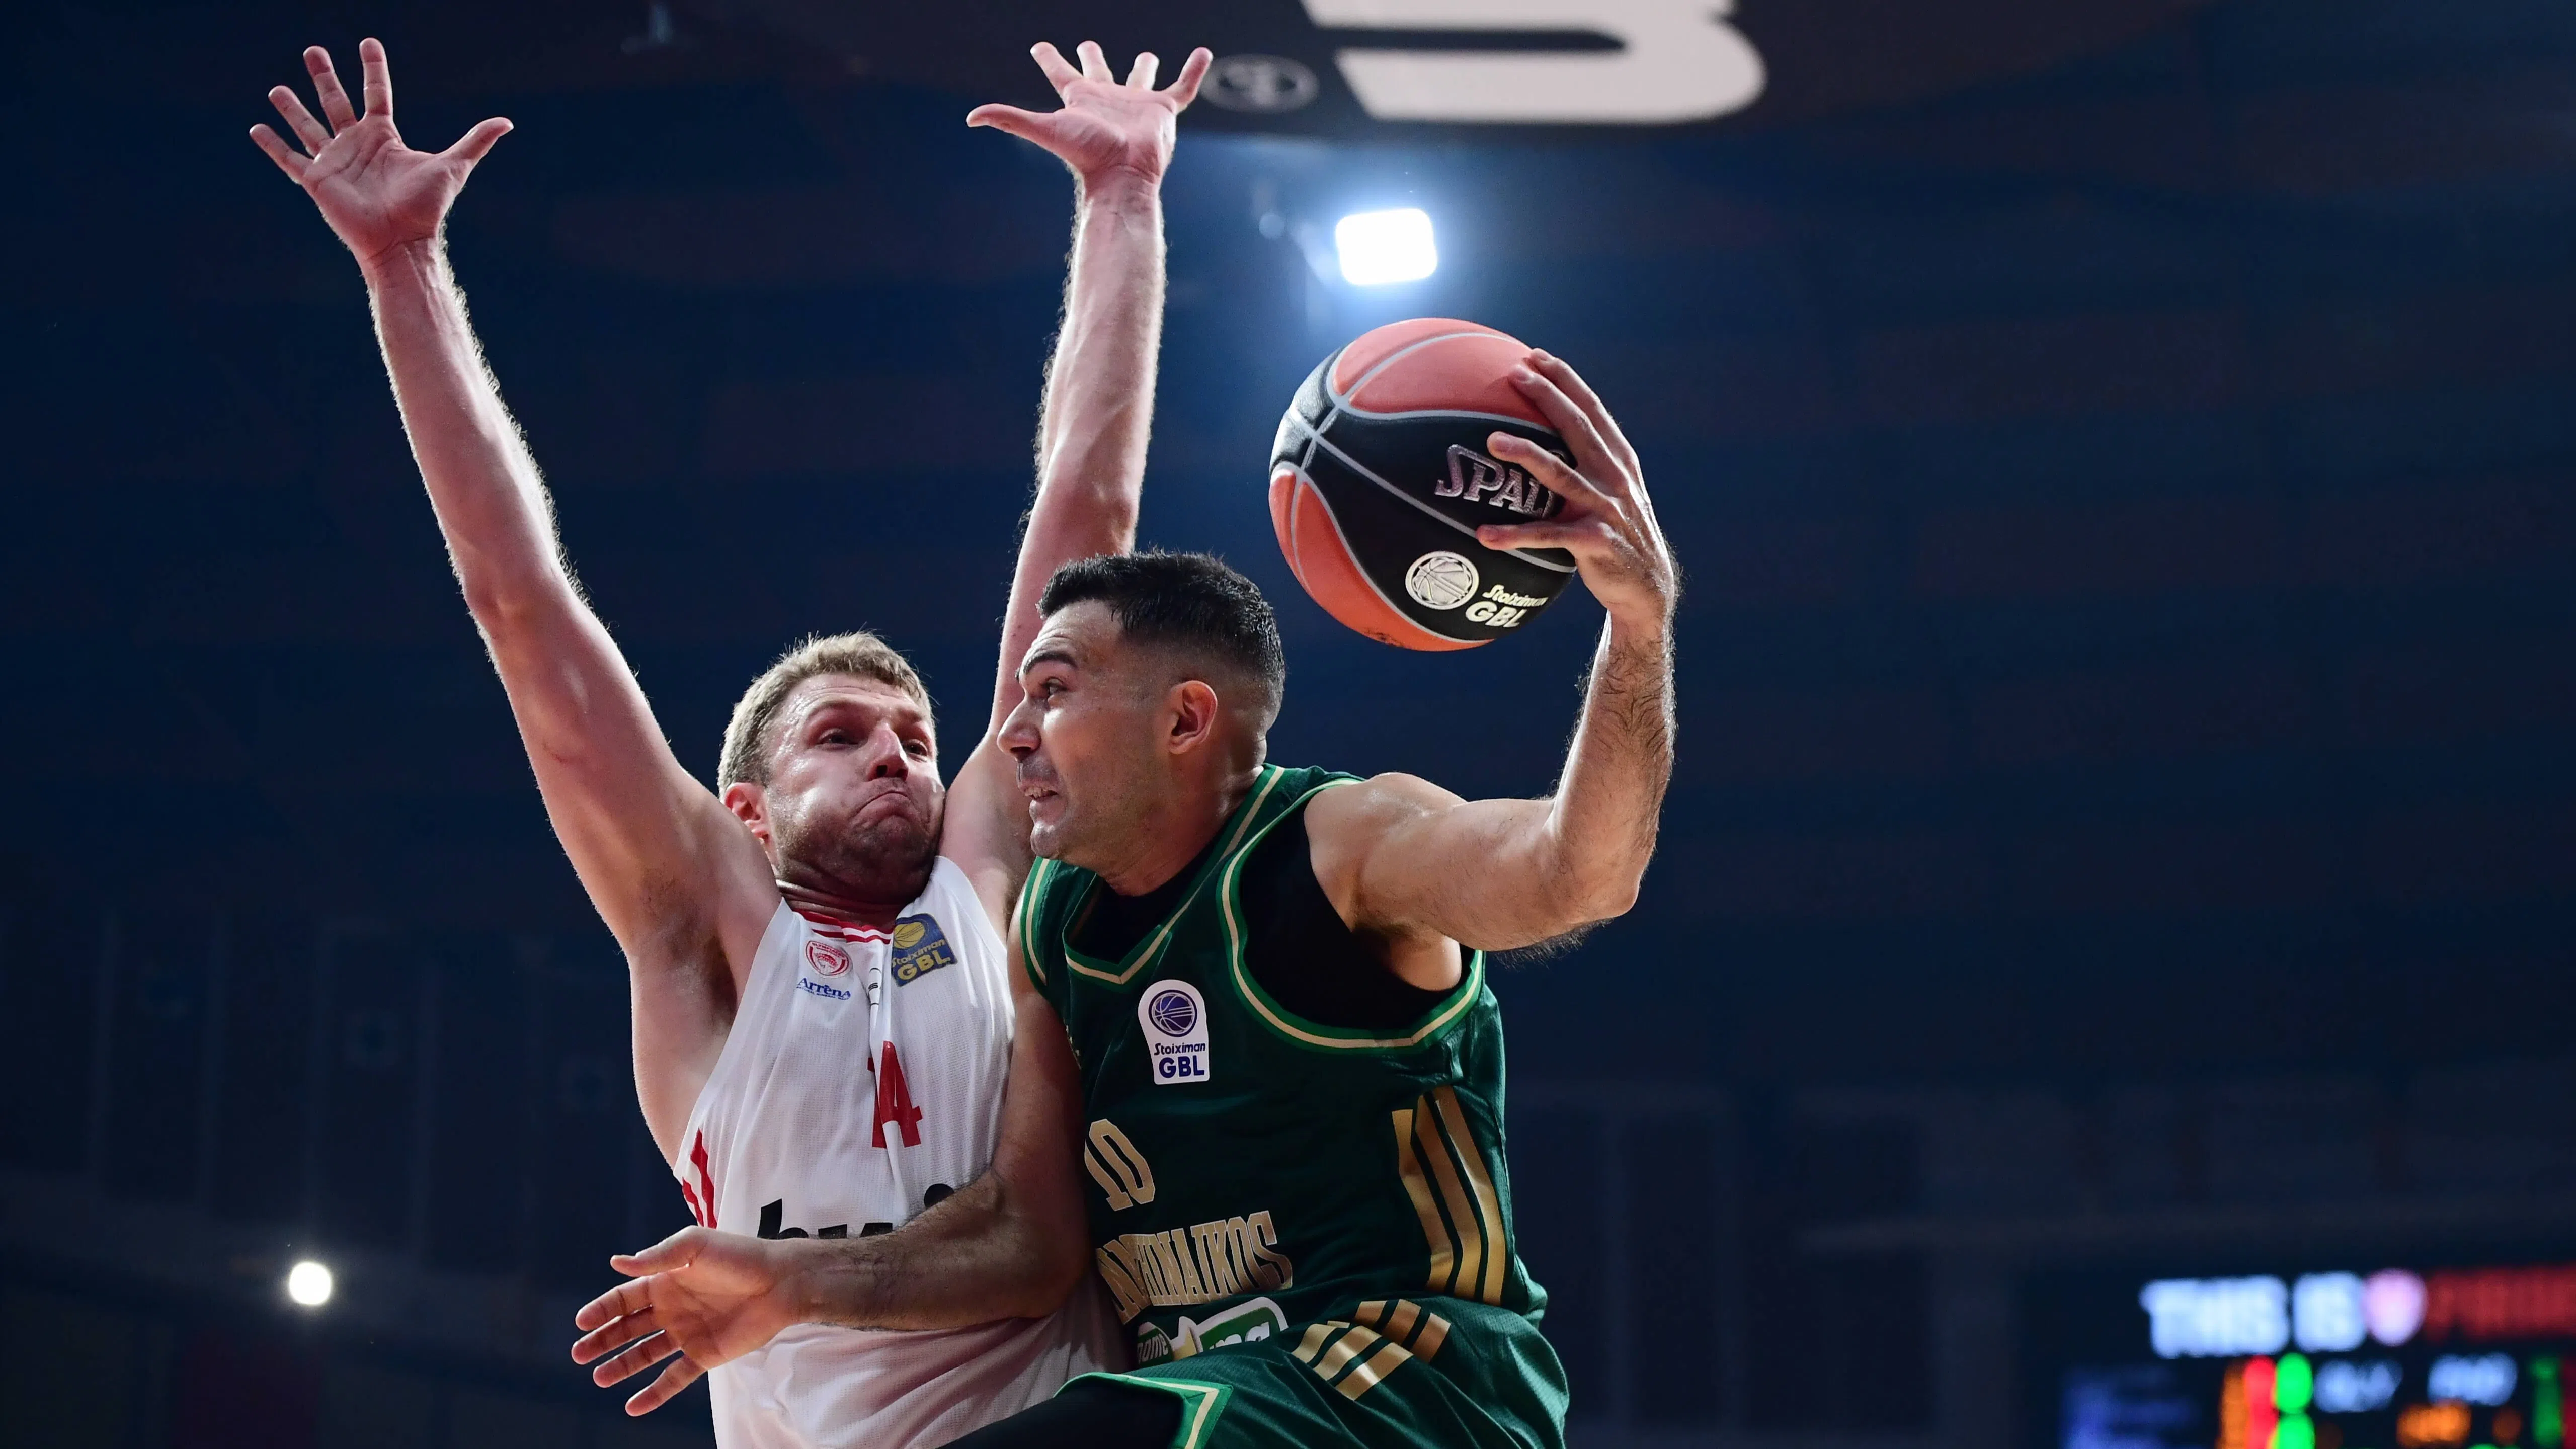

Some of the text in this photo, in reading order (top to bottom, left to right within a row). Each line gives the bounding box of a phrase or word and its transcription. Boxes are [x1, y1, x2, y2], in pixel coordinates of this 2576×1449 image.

[1435, 444, 1554, 519] SPAL
[1482, 584, 1548, 607] Stoiximan
[1465, 601, 1527, 627] GBL
[897, 950, 951, 980] GBL
[1154, 1042, 1205, 1056] Stoiximan
[1159, 1055, 1205, 1078] GBL
[1084, 1118, 1156, 1211] 10
